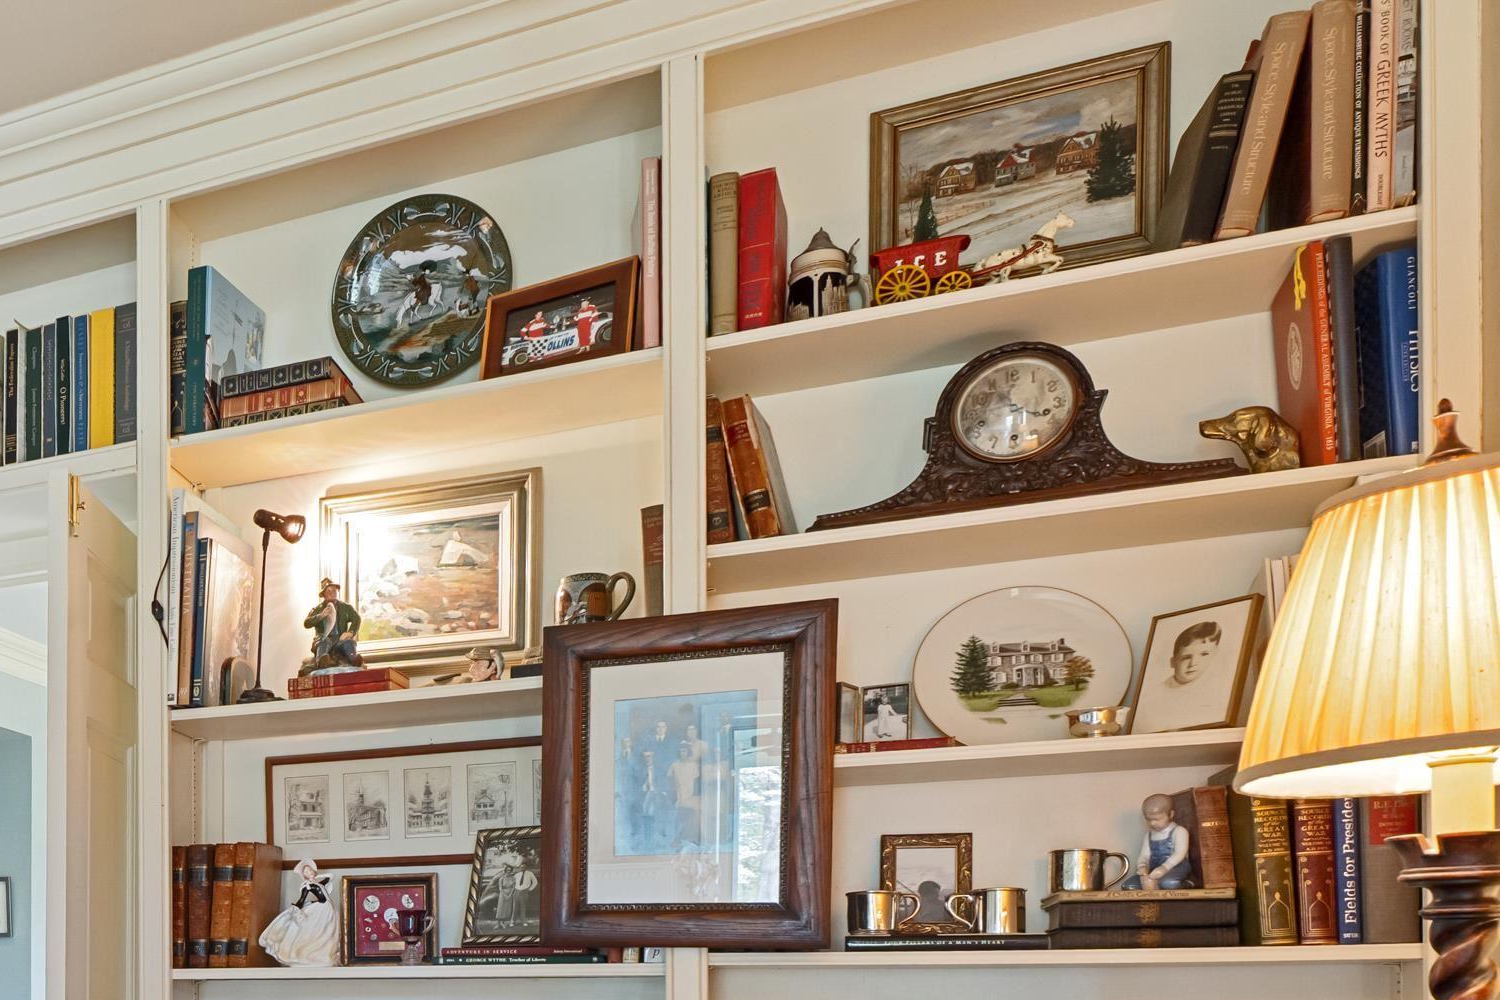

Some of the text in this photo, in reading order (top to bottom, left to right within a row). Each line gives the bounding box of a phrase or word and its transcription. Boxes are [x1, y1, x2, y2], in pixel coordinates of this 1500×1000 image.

[1355, 15, 1363, 60] WILLIAMSBURG
[1322, 68, 1336, 98] Style
[1354, 61, 1362, 98] COLLECTION
[1374, 11, 1390, 157] BOOK OF GREEK MYTHS
[1257, 84, 1277, 115] Style
[1323, 101, 1336, 124] and
[1253, 115, 1270, 139] and
[1239, 141, 1264, 194] Structure
[1322, 126, 1336, 178] Structure
[1354, 138, 1362, 178] FURNISHINGS
[895, 250, 947, 274] ICE
[1315, 252, 1325, 299] PROCEEDINGS
[1407, 256, 1415, 309] GIANCOLI
[1318, 308, 1326, 318] the
[1319, 319, 1328, 351] GENERAL
[1321, 353, 1330, 386] ASSEMBLY
[60, 386, 65, 394] O
[1323, 396, 1332, 428] VIRGINIA
[183, 544, 193, 614] AUSTRALIA
[1343, 858, 1356, 877] for
[1344, 881, 1356, 923] Fields
